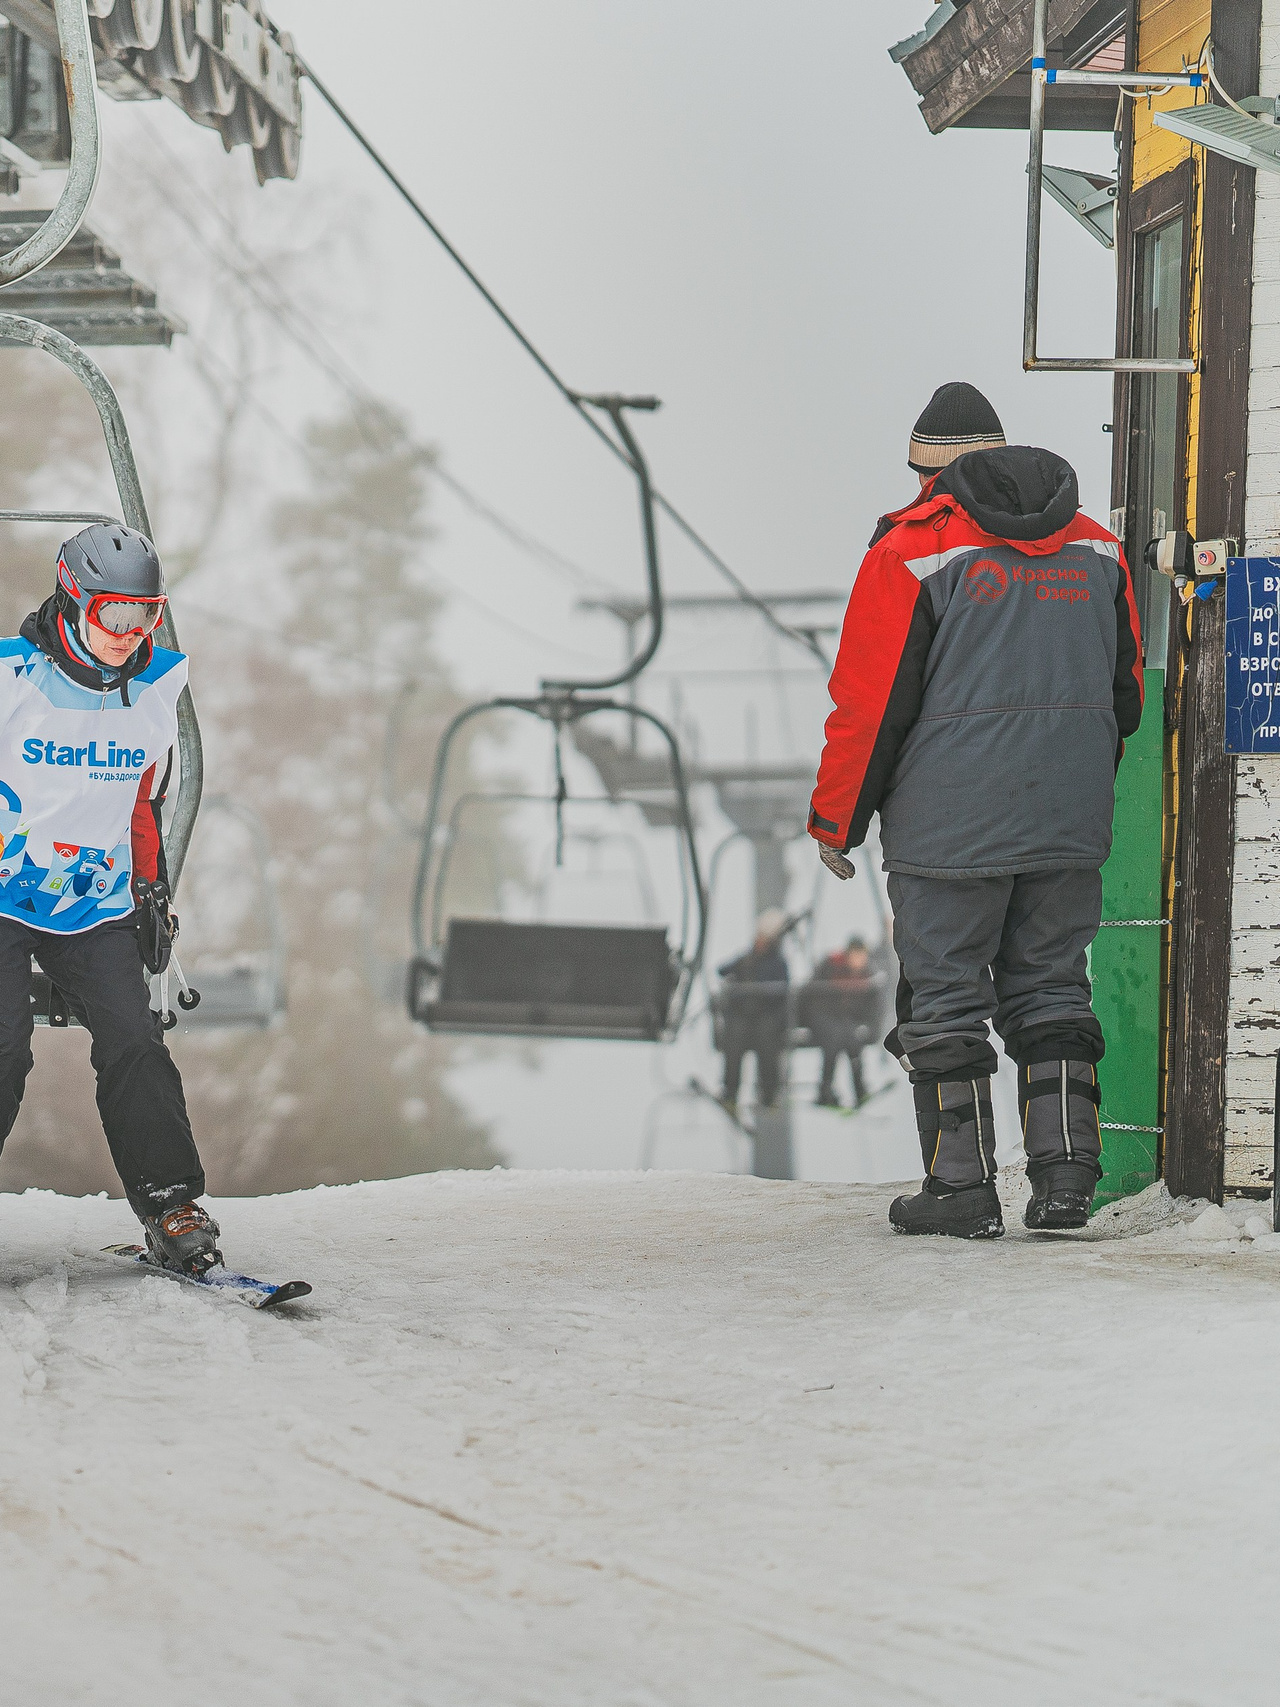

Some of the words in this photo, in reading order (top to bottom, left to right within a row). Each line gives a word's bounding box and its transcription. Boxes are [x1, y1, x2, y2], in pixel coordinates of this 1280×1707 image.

[1011, 565, 1088, 585] Красное
[1035, 584, 1090, 605] Озеро
[1252, 607, 1274, 622] ДО
[1253, 632, 1263, 646] В
[1260, 726, 1280, 738] ПР
[22, 738, 146, 768] StarLine
